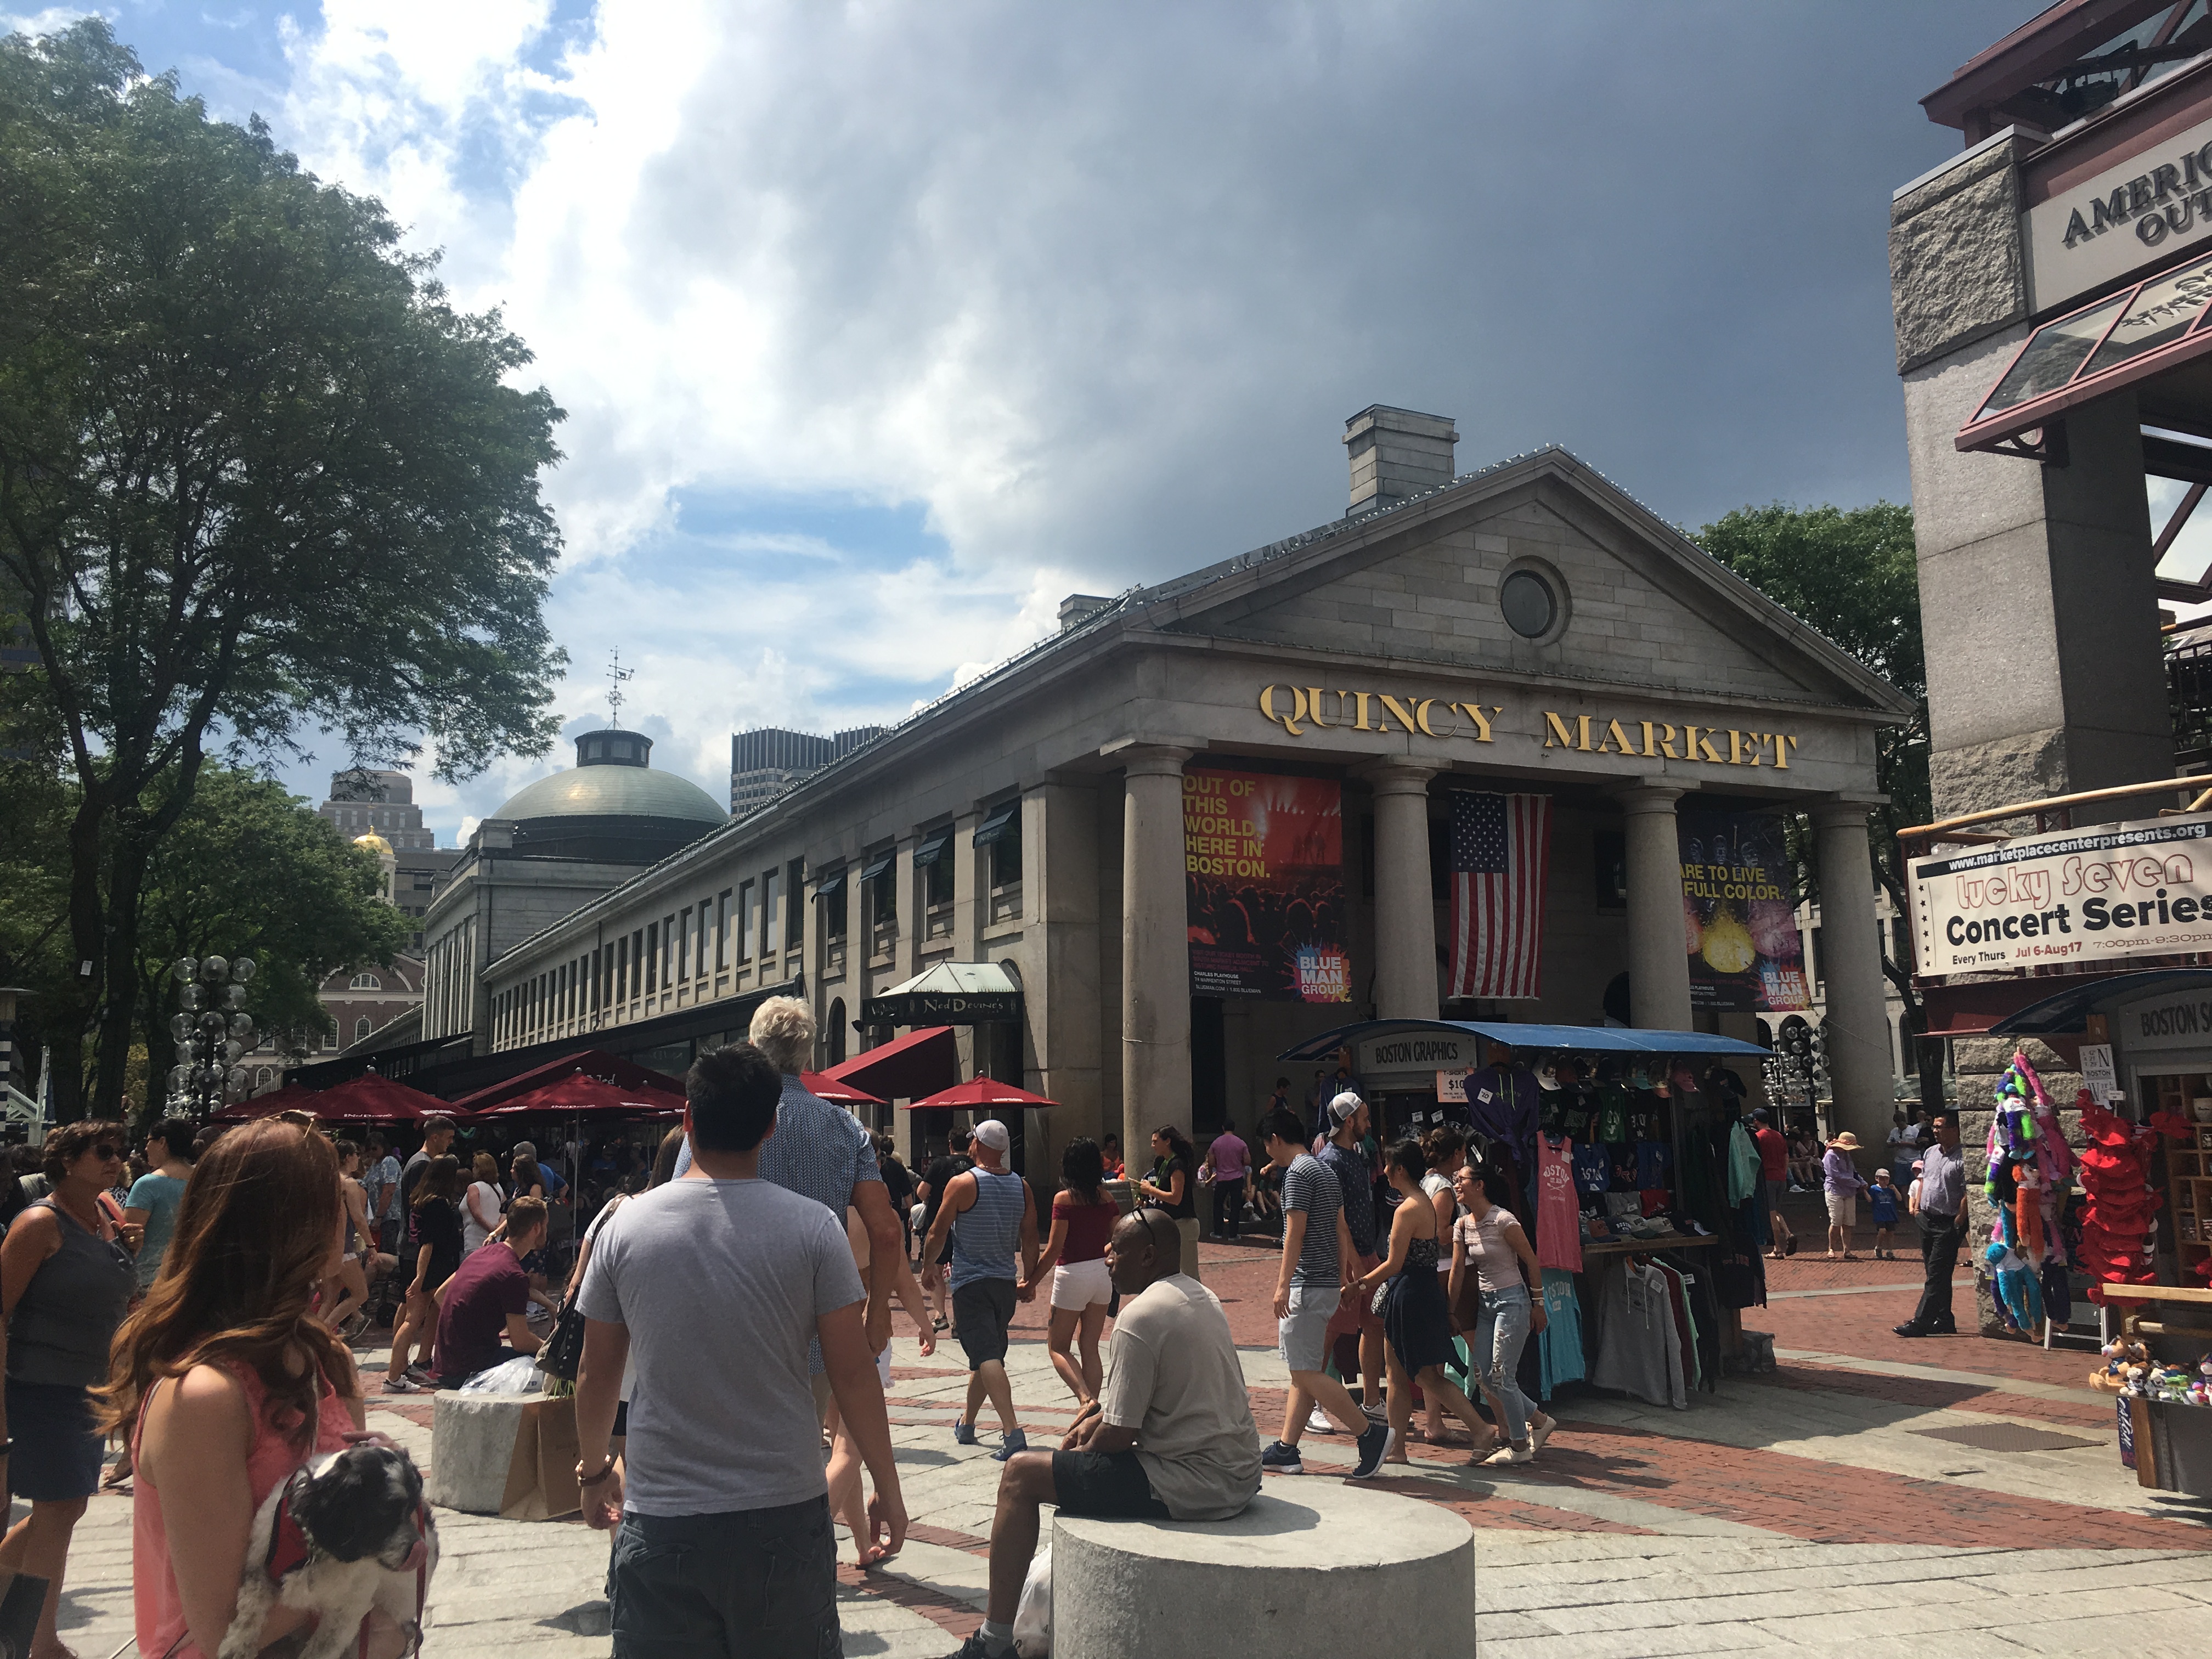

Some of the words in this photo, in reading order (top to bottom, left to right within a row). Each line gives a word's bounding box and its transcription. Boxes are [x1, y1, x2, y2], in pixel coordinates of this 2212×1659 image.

[1259, 684, 1503, 742] QUINCY
[1543, 712, 1796, 768] MARKET
[1183, 775, 1223, 794] OUT
[1230, 779, 1255, 797] OF
[1183, 795, 1228, 814] THIS
[1184, 815, 1261, 837] WORLD.
[1186, 834, 1236, 855] HERE
[1243, 839, 1262, 857] IN
[1949, 823, 2206, 871] www.marketplacecenterpresents.org
[1186, 855, 1271, 878] BOSTON.
[1708, 865, 1728, 881] TO
[1733, 867, 1767, 883] LIVE
[2063, 853, 2193, 895] Seven
[1684, 882, 1720, 898] FULL
[1724, 884, 1785, 900] COLOR.
[1946, 904, 2071, 946] Concert
[1300, 956, 1341, 969] BLUE
[1953, 953, 1976, 965] Every
[1979, 950, 2006, 962] Thurs
[2016, 946, 2030, 958] Jul
[1301, 970, 1342, 984] MAN
[1763, 971, 1800, 983] BLUE
[1301, 985, 1344, 995] GROUP
[1765, 983, 1803, 996] MAN
[923, 998, 950, 1014] Ned
[1768, 996, 1805, 1005] GROUP
[2141, 1003, 2198, 1037] BOSTON
[1375, 1042, 1411, 1063] BOSTON
[1414, 1041, 1458, 1061] GRAPHICS
